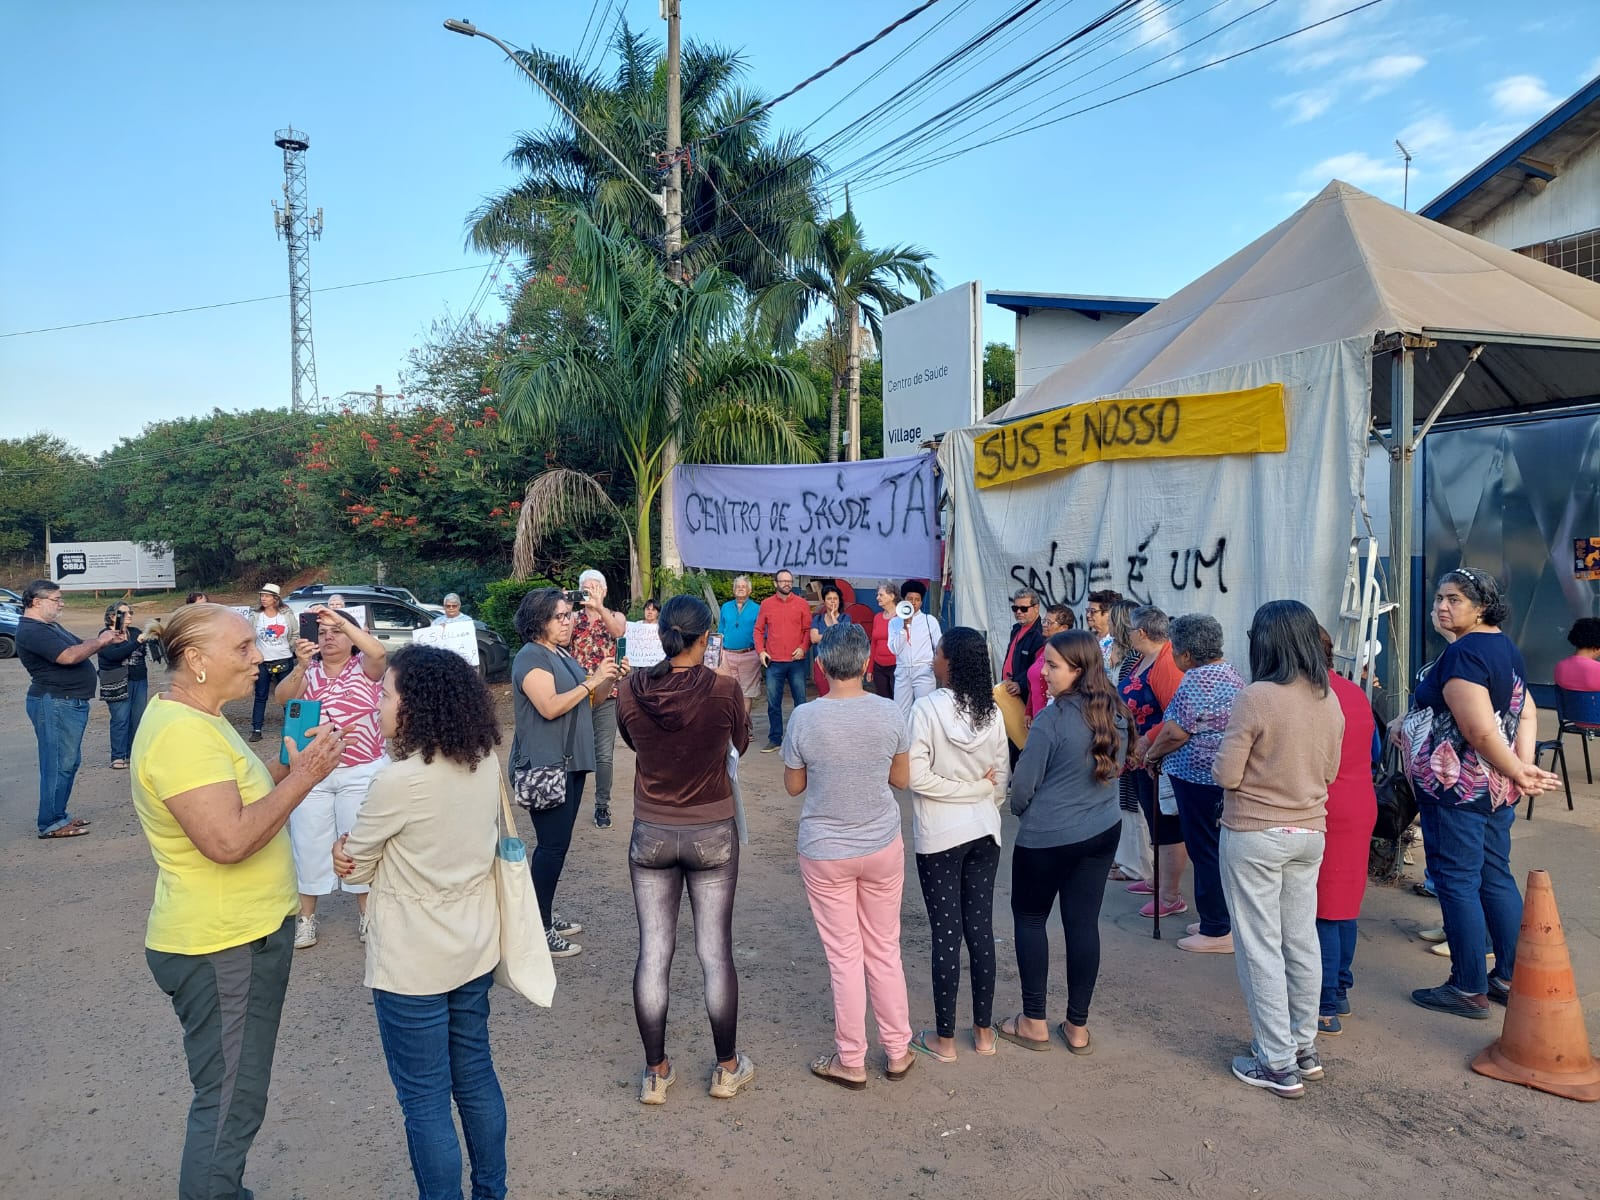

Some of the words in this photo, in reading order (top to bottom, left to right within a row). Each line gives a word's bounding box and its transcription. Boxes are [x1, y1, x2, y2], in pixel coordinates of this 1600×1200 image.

[888, 375, 912, 393] Centro
[913, 371, 923, 386] de
[924, 364, 949, 383] Saúde
[888, 426, 922, 445] Village
[976, 422, 1045, 480] SUS
[1053, 412, 1072, 456] É
[1081, 398, 1181, 452] NOSSO
[684, 492, 761, 536] CENTRO
[770, 501, 791, 532] DE
[800, 471, 873, 534] SAÚDE
[754, 534, 850, 568] VILLAGE
[1009, 541, 1112, 609] SAÚDE
[1127, 522, 1160, 606] É
[1170, 537, 1228, 595] UM
